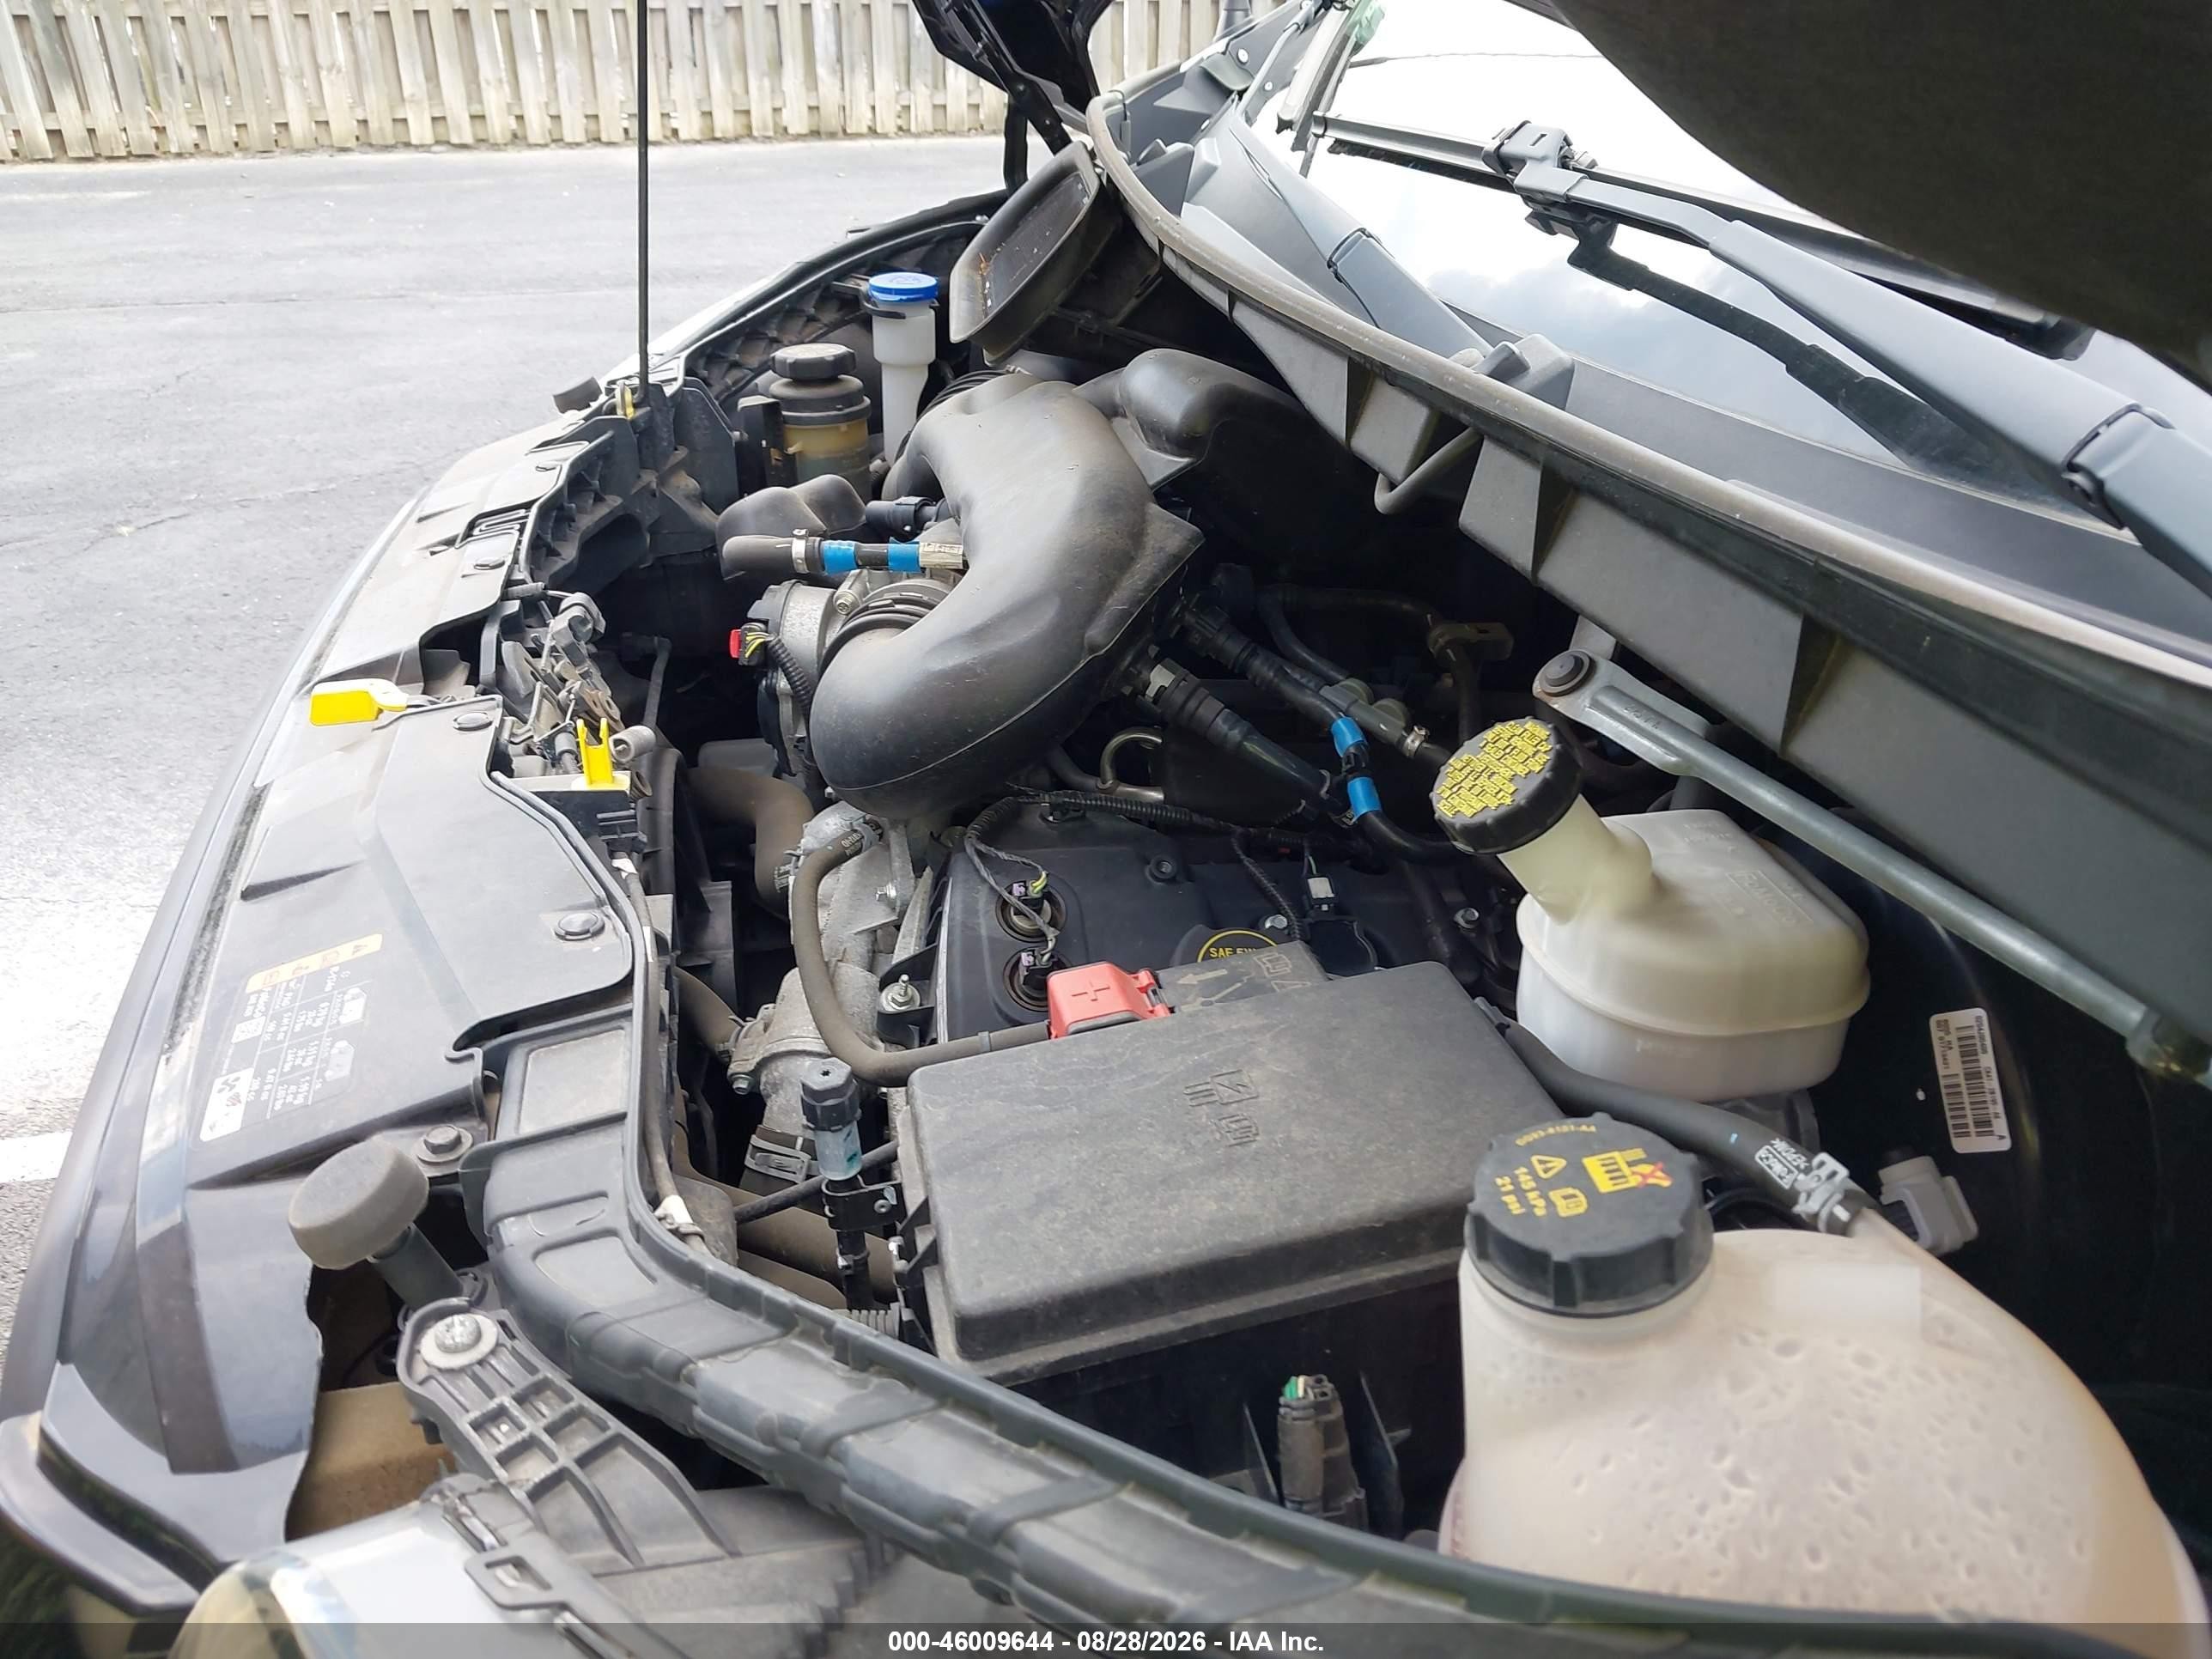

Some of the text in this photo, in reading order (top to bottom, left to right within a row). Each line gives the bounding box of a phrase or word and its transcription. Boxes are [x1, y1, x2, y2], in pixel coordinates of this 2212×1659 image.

[1495, 1176, 1527, 1215] 21 psi
[1514, 1167, 1547, 1217] 145 kPa
